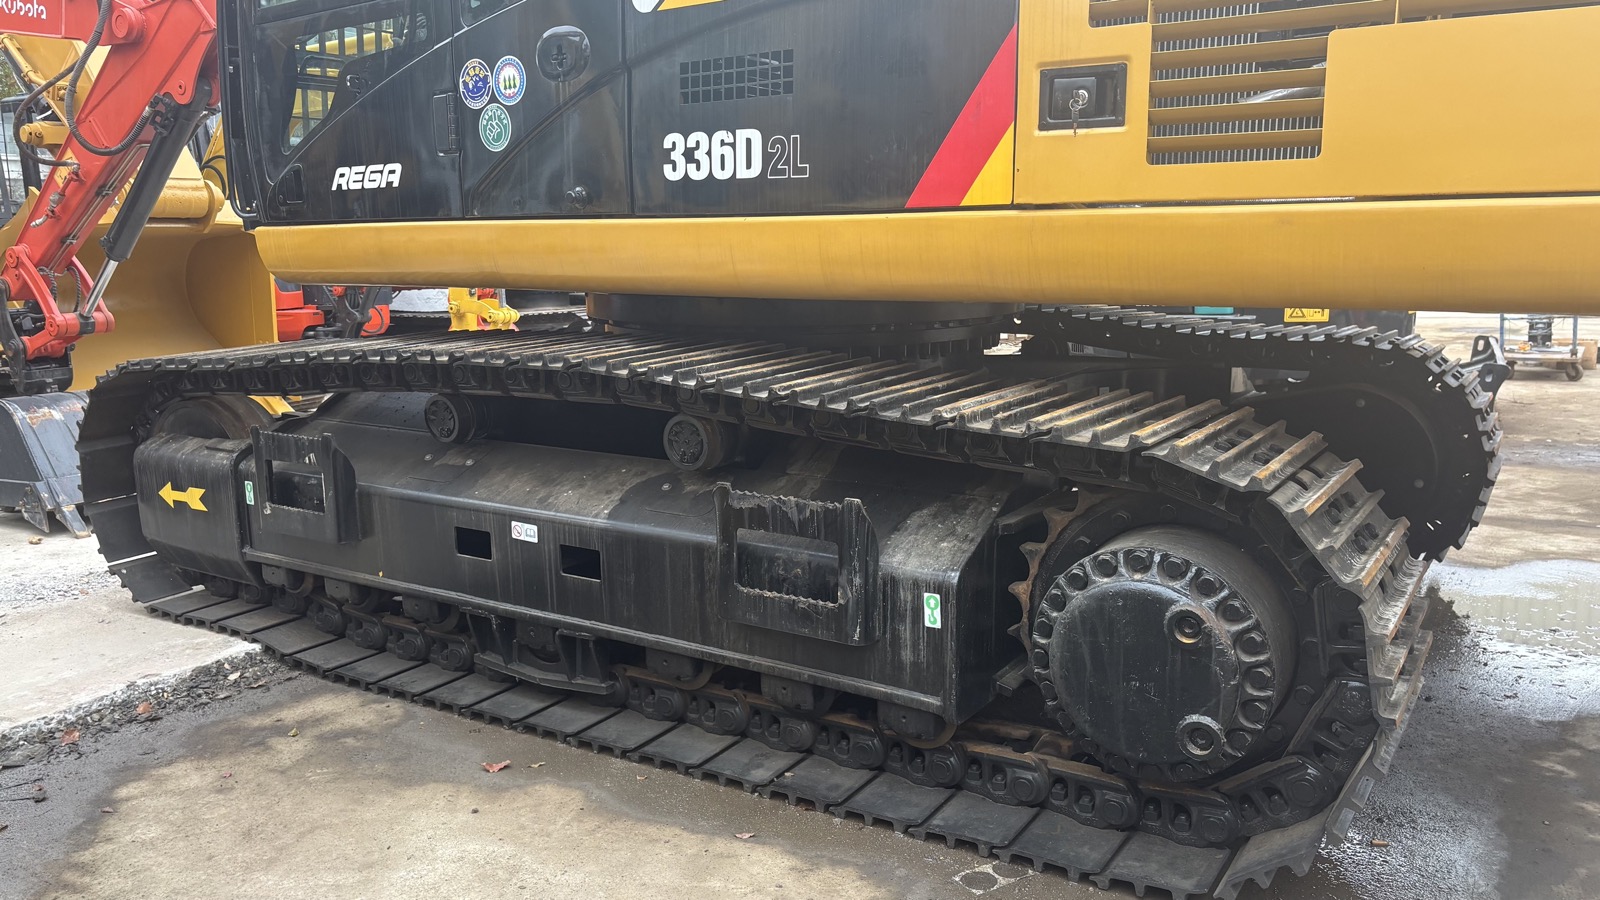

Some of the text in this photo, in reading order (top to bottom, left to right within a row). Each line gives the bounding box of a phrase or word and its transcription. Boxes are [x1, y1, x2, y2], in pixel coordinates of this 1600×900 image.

[663, 128, 810, 181] 336D 2L
[331, 162, 403, 191] REGA
